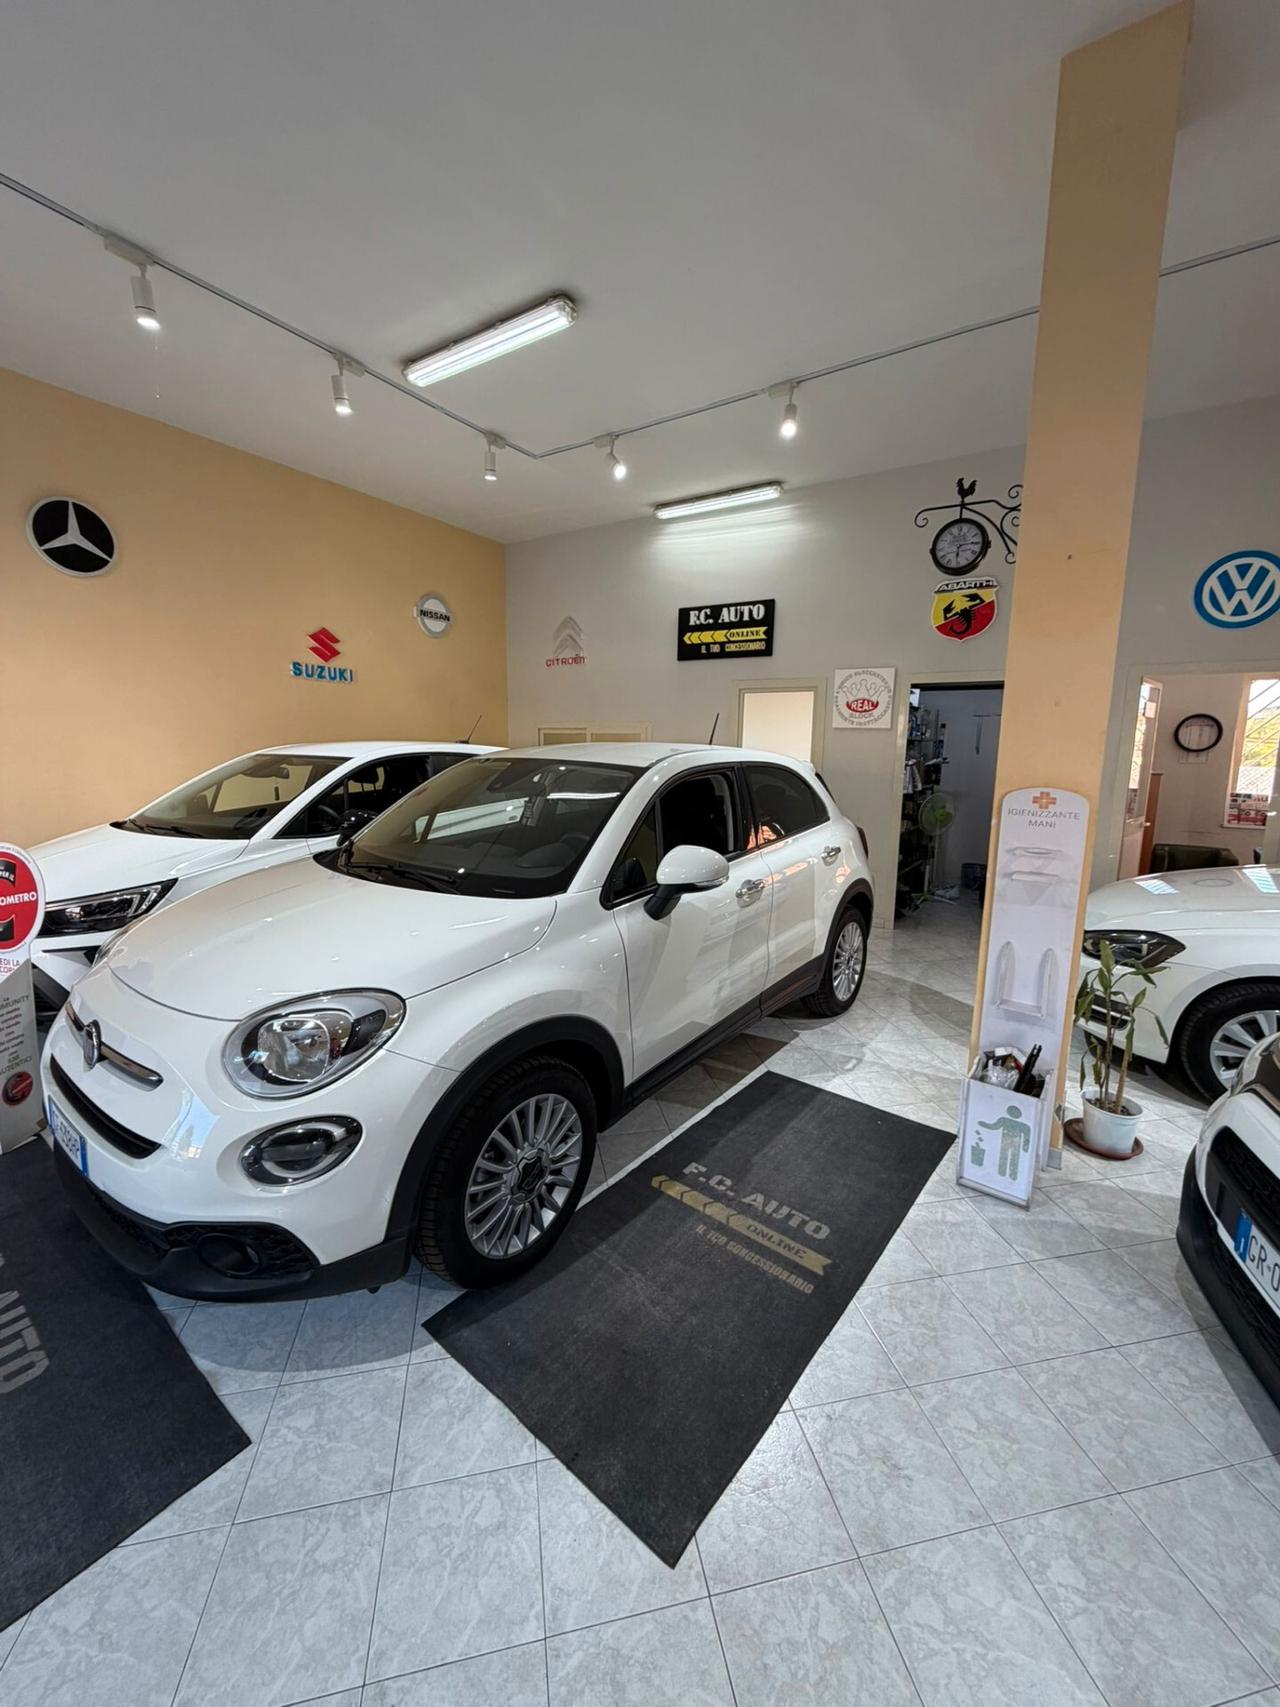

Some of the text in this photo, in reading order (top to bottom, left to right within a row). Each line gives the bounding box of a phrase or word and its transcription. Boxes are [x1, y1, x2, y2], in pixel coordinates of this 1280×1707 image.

[940, 579, 994, 591] ABARTH
[419, 609, 450, 622] NISSAN
[689, 604, 765, 626] F.C. AUTO
[729, 629, 761, 638] ONLINE
[291, 661, 353, 682] SUZUKI
[851, 700, 877, 711] REAL
[1008, 807, 1081, 820] IGIENIZZANTE
[1028, 819, 1056, 829] MANI
[682, 1162, 831, 1240] F.C. AUTO
[747, 1224, 807, 1260] ONLINE
